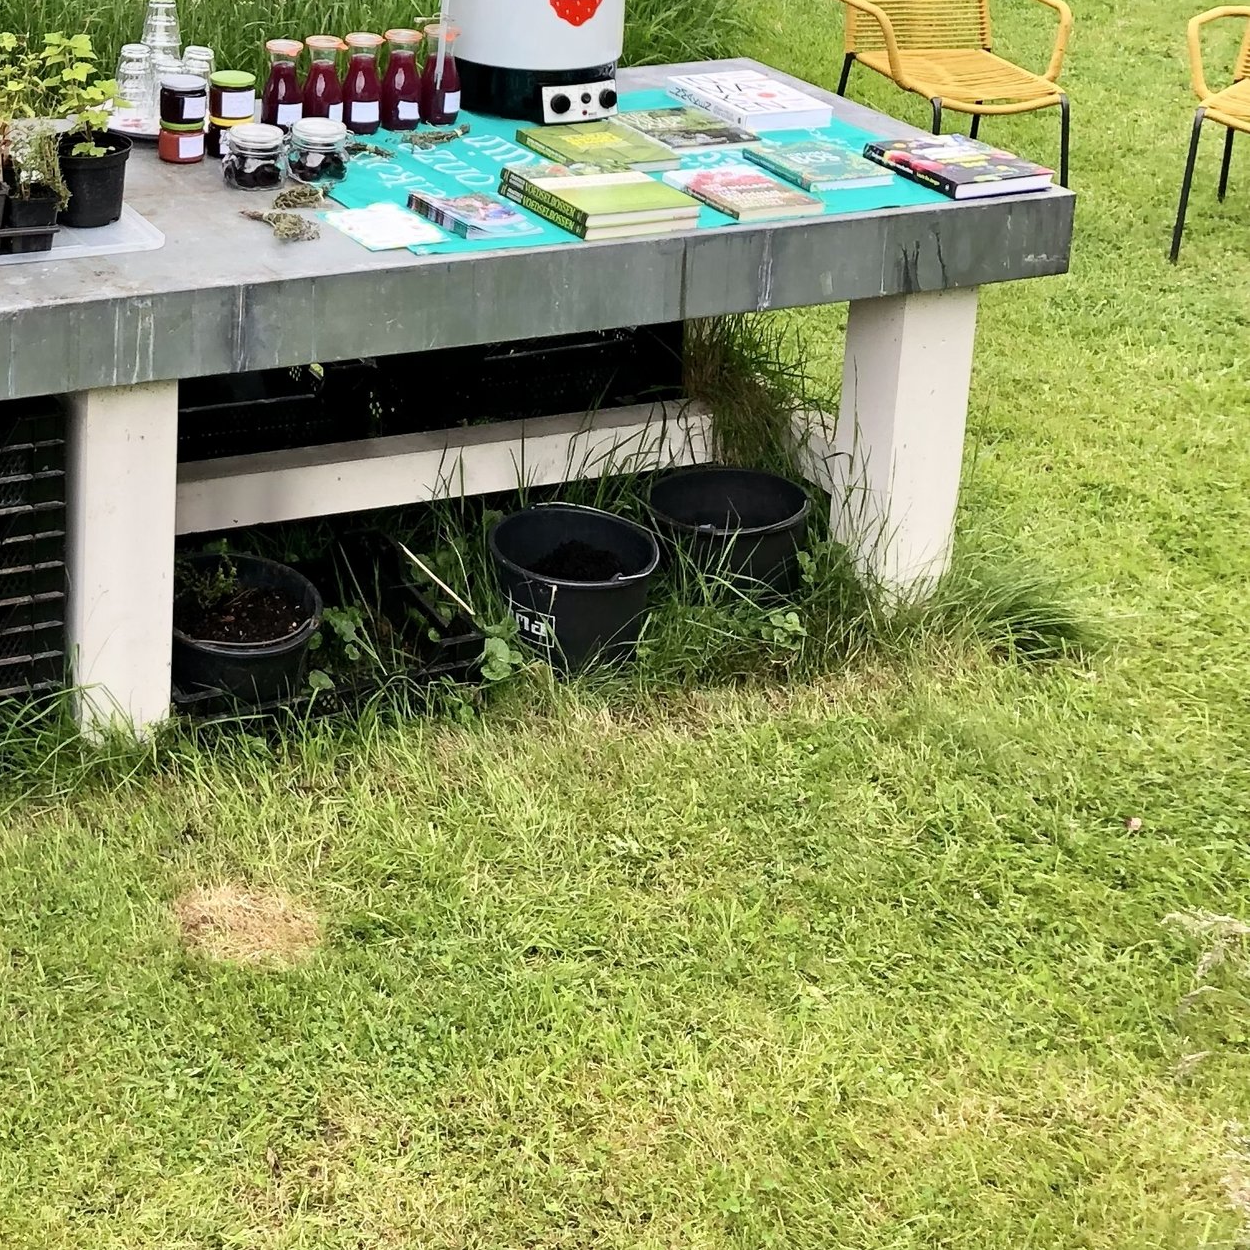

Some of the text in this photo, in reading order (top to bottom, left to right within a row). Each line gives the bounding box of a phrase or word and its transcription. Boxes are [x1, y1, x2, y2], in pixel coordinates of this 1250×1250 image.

[462, 134, 538, 167] uin
[522, 195, 576, 230] VOEDSELBOSSEN
[524, 181, 576, 218] VOEDSELBOSSEN
[515, 612, 548, 637] ma
